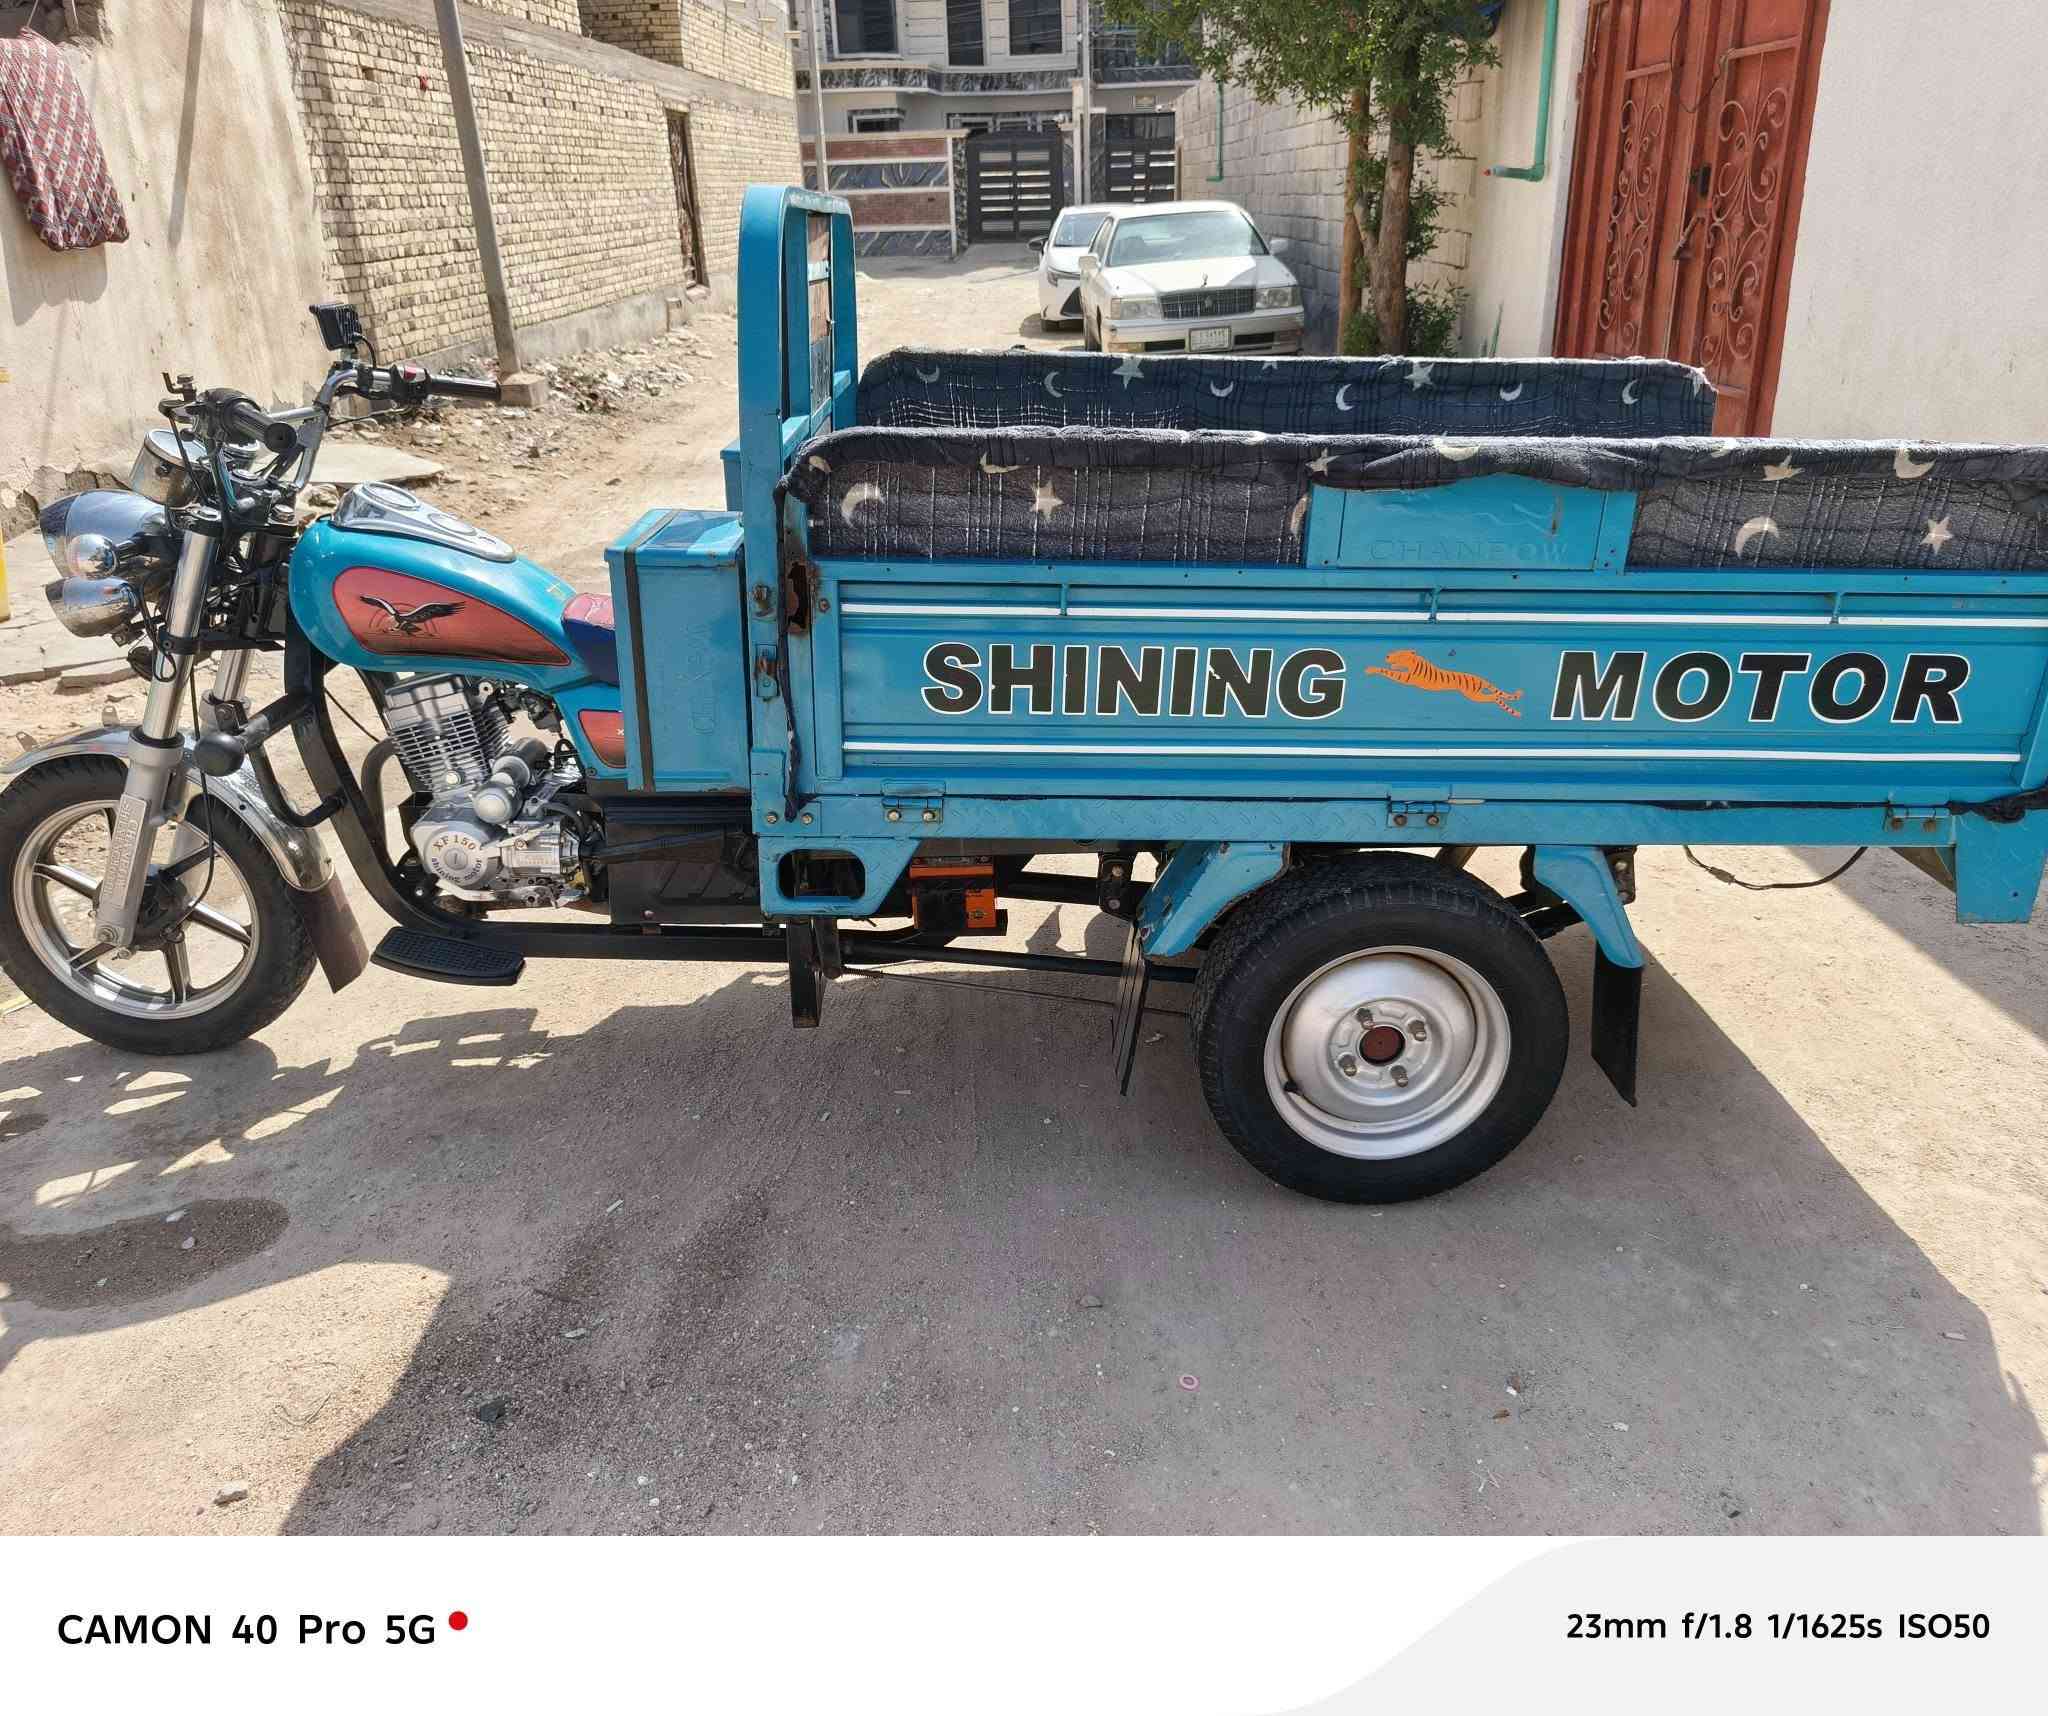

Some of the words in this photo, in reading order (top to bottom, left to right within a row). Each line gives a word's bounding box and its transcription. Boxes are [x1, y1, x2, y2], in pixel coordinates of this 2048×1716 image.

[921, 642, 1345, 720] SHINING
[1550, 649, 1970, 725] MOTOR
[454, 834, 476, 850] 150
[463, 858, 482, 881] motor
